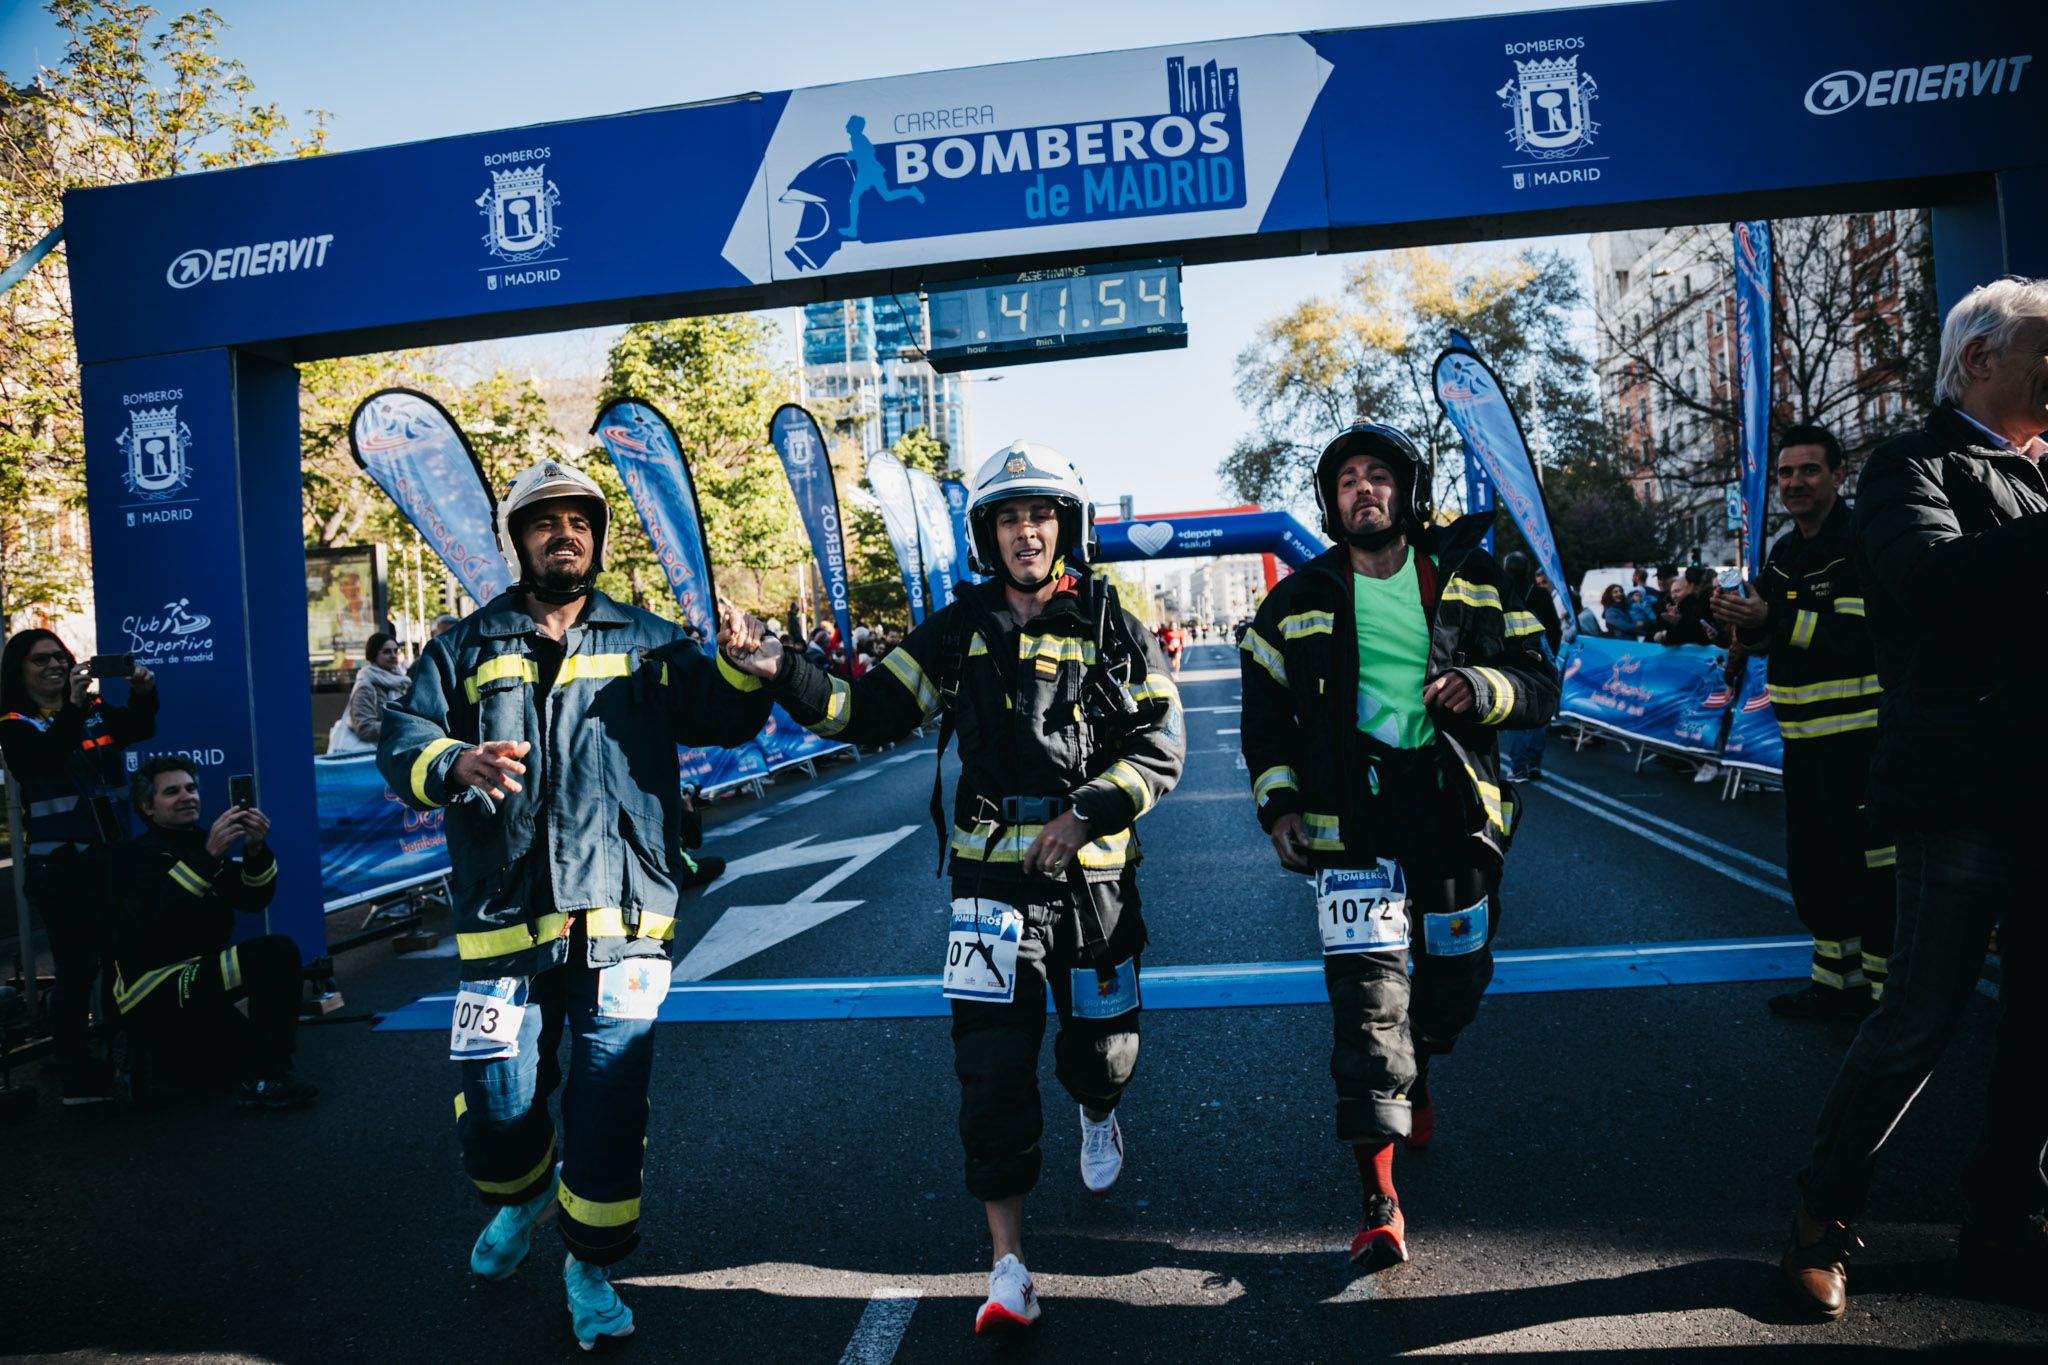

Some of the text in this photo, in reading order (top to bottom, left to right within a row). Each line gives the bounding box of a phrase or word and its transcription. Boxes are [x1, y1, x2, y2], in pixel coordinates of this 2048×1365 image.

[1504, 37, 1585, 56] BOMBEROS
[1865, 55, 2032, 107] ENERVIT
[893, 105, 994, 135] CARRERA
[484, 147, 551, 167] BOMBEROS
[895, 112, 1230, 184] BOMBEROS
[1535, 168, 1601, 186] MADRID
[1025, 156, 1235, 221] de MADRID
[210, 234, 334, 281] ENERVIT
[504, 268, 561, 287] MADRID
[966, 345, 989, 354] hour
[122, 388, 184, 406] BOMBEROS
[142, 506, 193, 523] MADRID
[122, 616, 161, 634] Club
[129, 633, 214, 656] Deportivo
[134, 652, 214, 666] mberos de madrid
[1328, 896, 1393, 925] 1072
